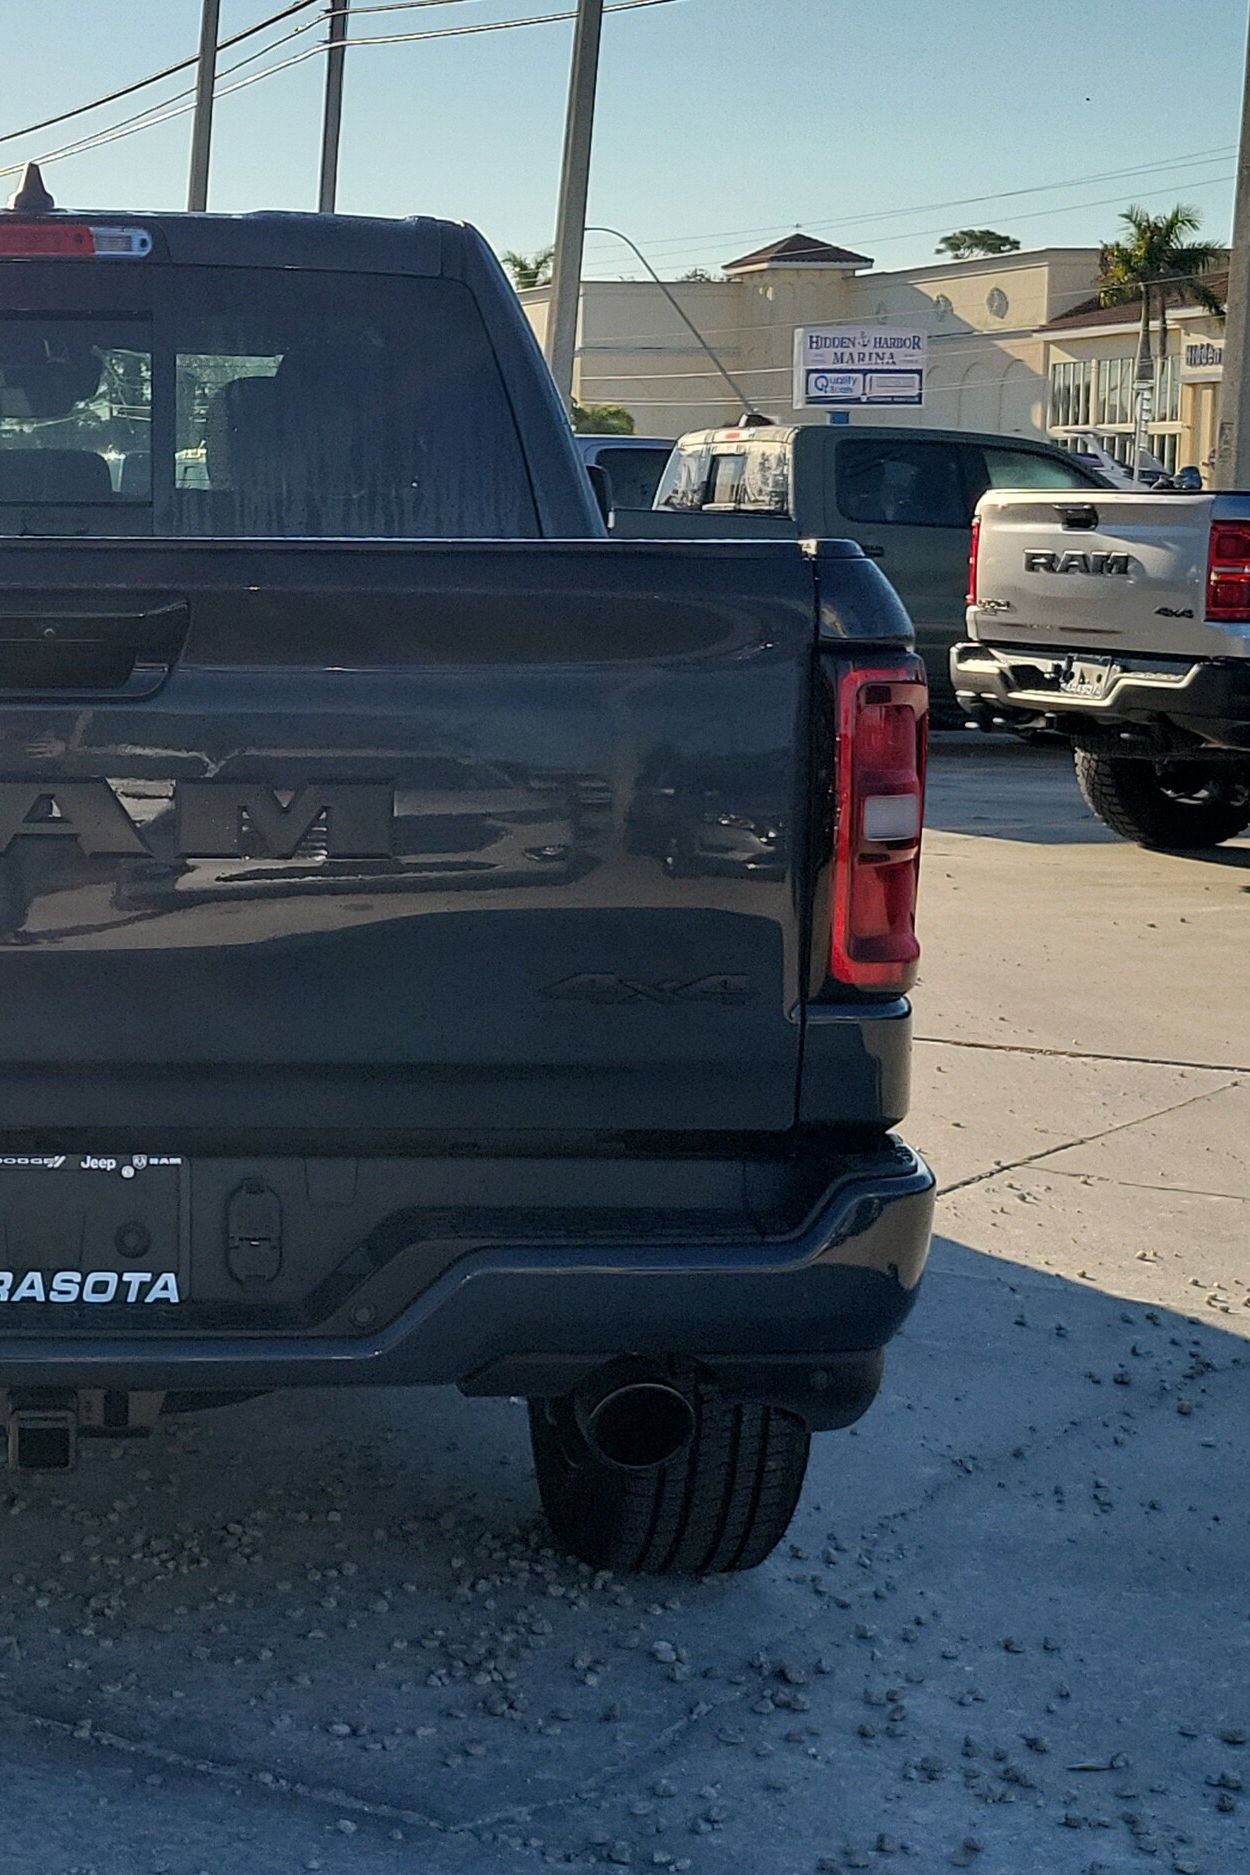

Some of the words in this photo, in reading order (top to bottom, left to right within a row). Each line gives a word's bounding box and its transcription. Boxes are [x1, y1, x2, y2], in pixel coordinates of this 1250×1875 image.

[808, 335, 856, 350] HIDDEN
[873, 335, 921, 350] HARBOR
[832, 352, 897, 365] MARINA
[814, 375, 858, 394] Quality
[1023, 549, 1129, 575] RAM
[80, 1155, 116, 1171] Jeep
[149, 1157, 182, 1165] RAM
